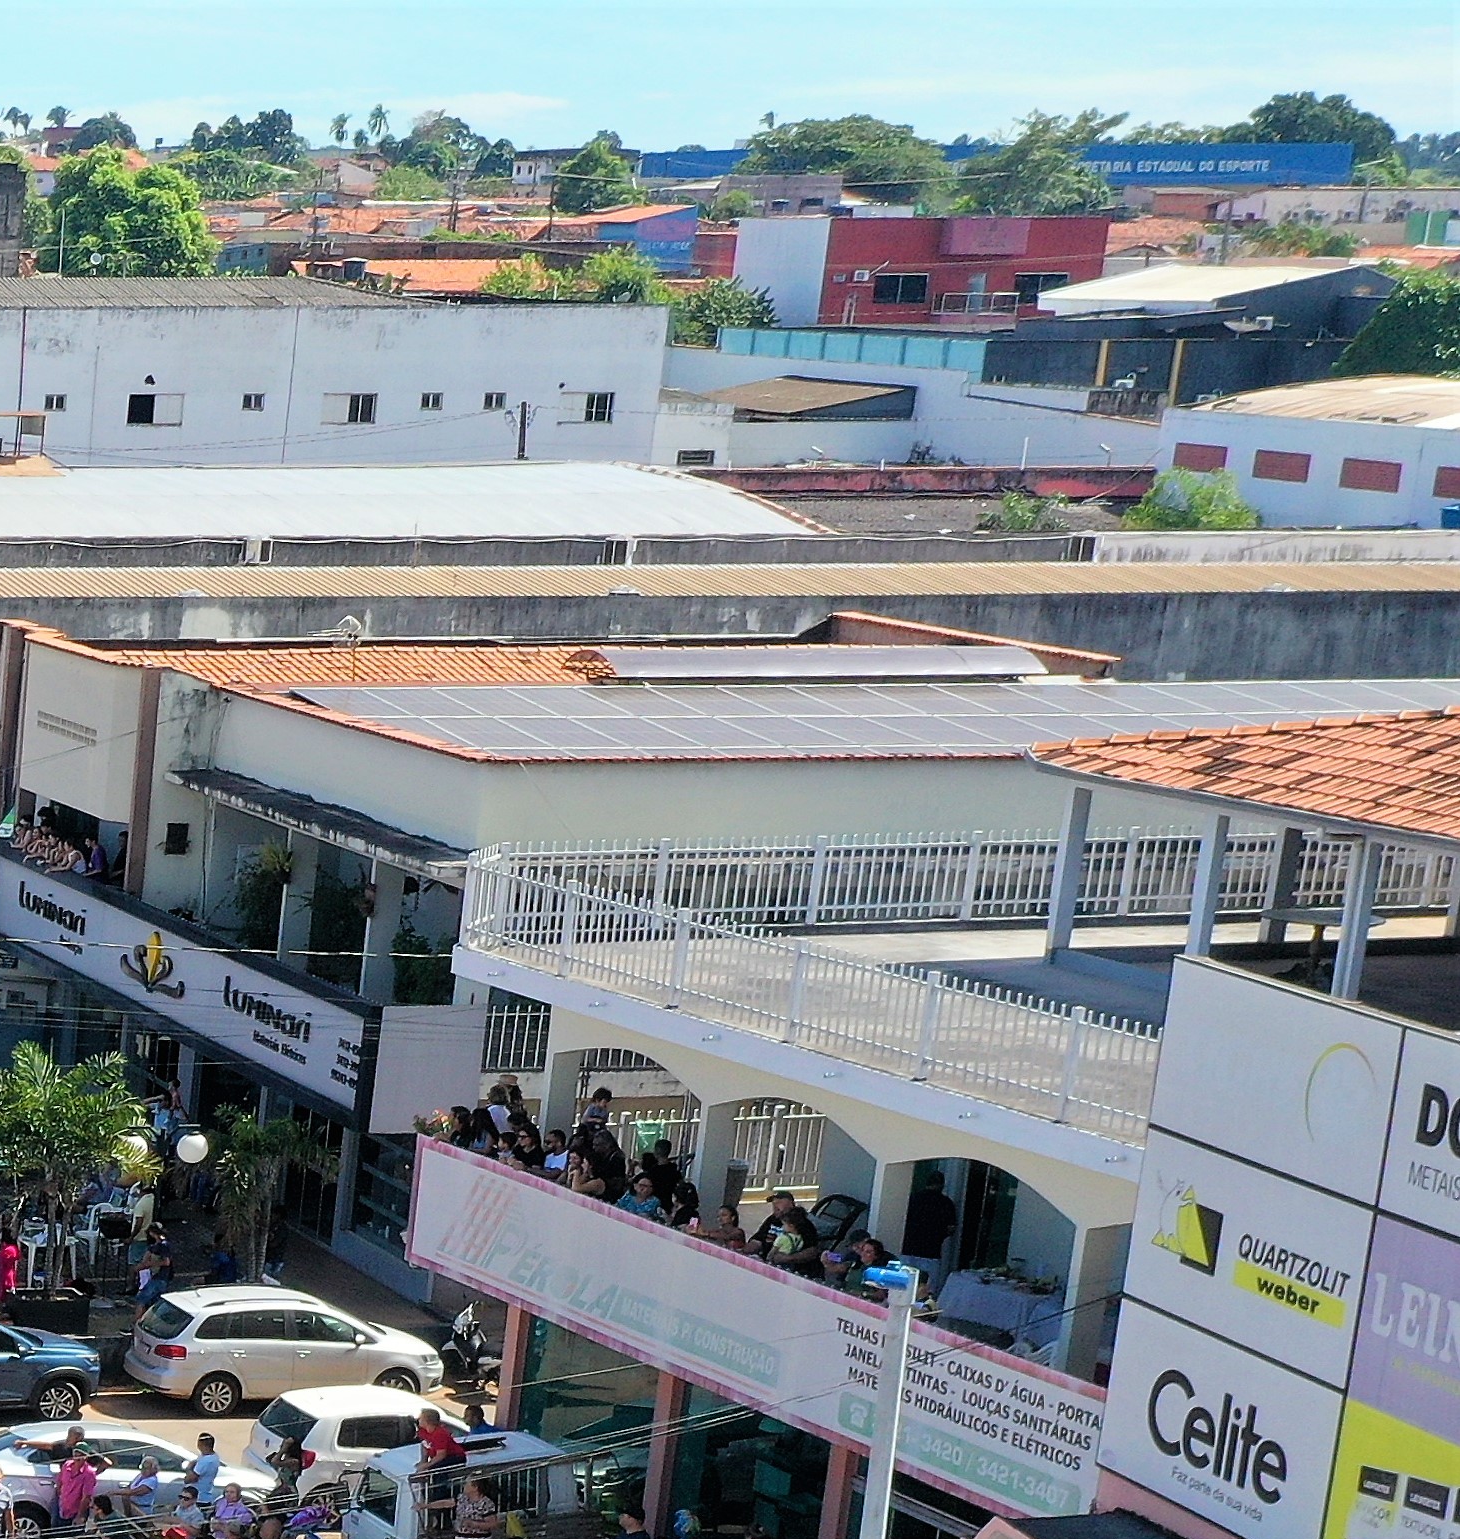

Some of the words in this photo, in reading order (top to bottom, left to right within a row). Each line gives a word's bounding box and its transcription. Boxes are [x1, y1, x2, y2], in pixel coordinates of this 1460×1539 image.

[1217, 158, 1270, 173] ESPORTE
[1238, 1233, 1351, 1298] QUARTZOLIT
[1256, 1276, 1320, 1315] weber
[837, 1317, 879, 1347] TELHAS
[947, 1360, 993, 1387] CAIXAS
[1010, 1380, 1046, 1410] ÁGUA
[905, 1367, 949, 1396] TINTAS
[961, 1390, 1010, 1420] LOUÇAS
[1012, 1408, 1092, 1451] SANITÁRIAS
[914, 1393, 998, 1439] HIDRÁULICOS
[1001, 1427, 1008, 1444] E
[1010, 1431, 1082, 1472] ELÉTRICOS
[1147, 1368, 1287, 1505] Celite
[1171, 1466, 1187, 1486] Faz
[1188, 1476, 1212, 1497] parte
[1212, 1488, 1225, 1503] da
[1224, 1495, 1242, 1512] sua
[1244, 1503, 1264, 1522] vida
